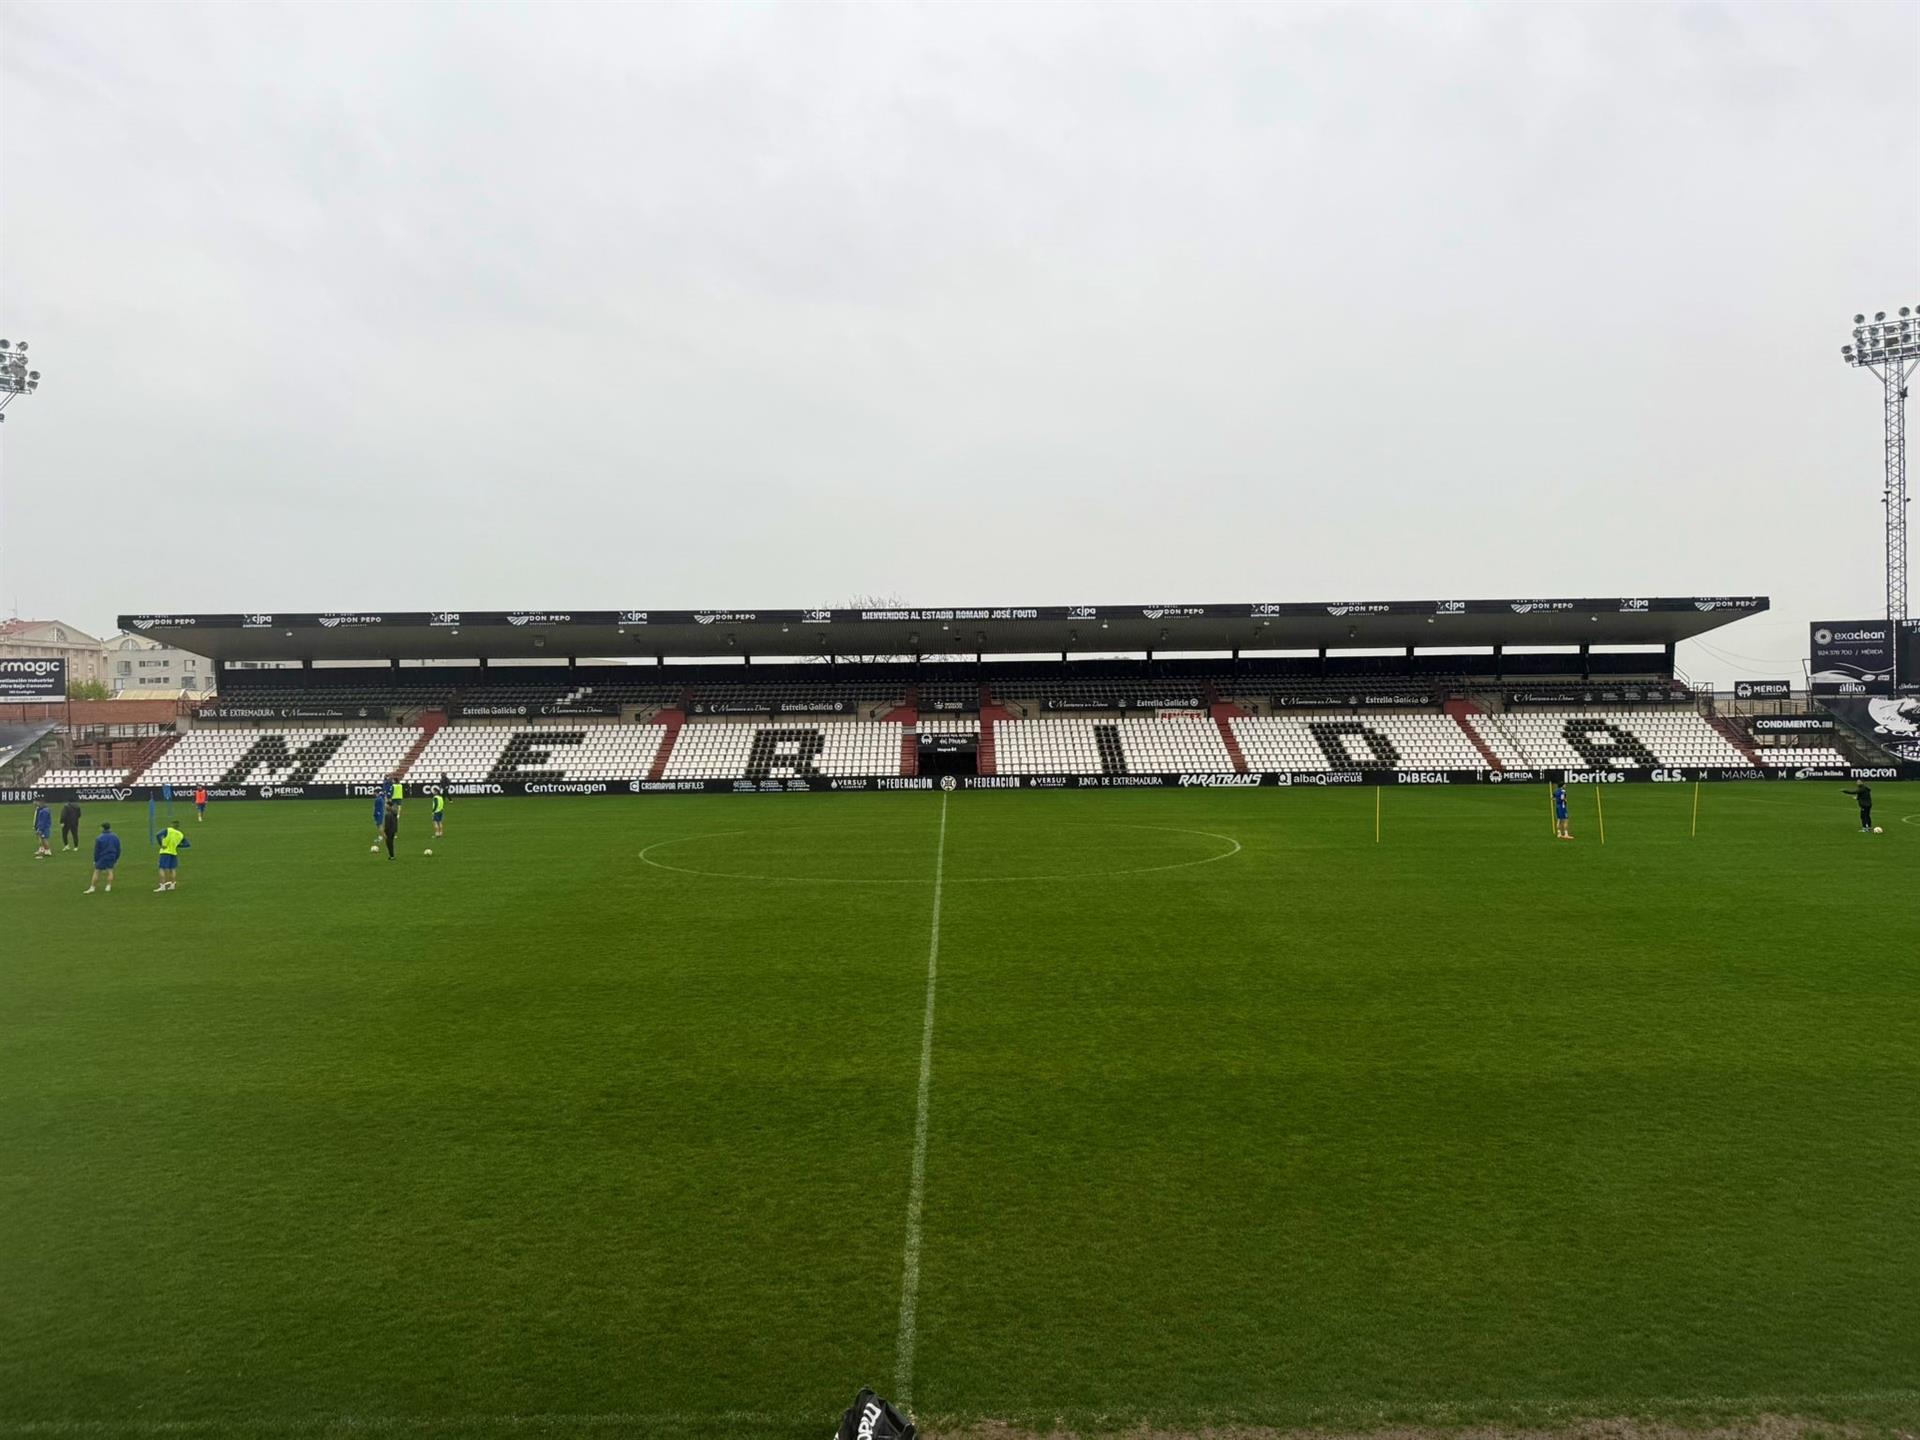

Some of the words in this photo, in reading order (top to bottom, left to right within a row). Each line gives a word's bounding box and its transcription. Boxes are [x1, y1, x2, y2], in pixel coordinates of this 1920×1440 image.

[862, 612, 909, 620] BIENVENIDOS
[922, 611, 954, 619] ESTADIO
[956, 610, 989, 619] ROMANO
[991, 608, 1011, 618] JOSÉ
[1834, 630, 1885, 640] exaclean
[0, 662, 60, 676] rmagic
[1136, 699, 1163, 707] Estrella
[1164, 698, 1189, 707] Galicia
[1365, 696, 1392, 704] Estrella
[1393, 696, 1418, 704] Galicia
[463, 706, 490, 715] Estrella
[491, 706, 516, 714] Galicia
[781, 702, 807, 711] Estrella
[809, 702, 833, 710] Galicia
[230, 709, 274, 717] EXTREMADURA
[1564, 771, 1625, 783] Iberitos
[1722, 770, 1764, 779] MAMBA
[1851, 768, 1897, 778] macron
[886, 778, 932, 789] FEDERACIÓN
[974, 777, 1020, 788] FEDERACIÓN
[1078, 777, 1097, 786] JUNTA
[1101, 777, 1110, 786] DE
[1112, 777, 1163, 786] EXTREMADURA
[1178, 774, 1262, 787] RARATRANS
[525, 782, 606, 794] Centrowagen
